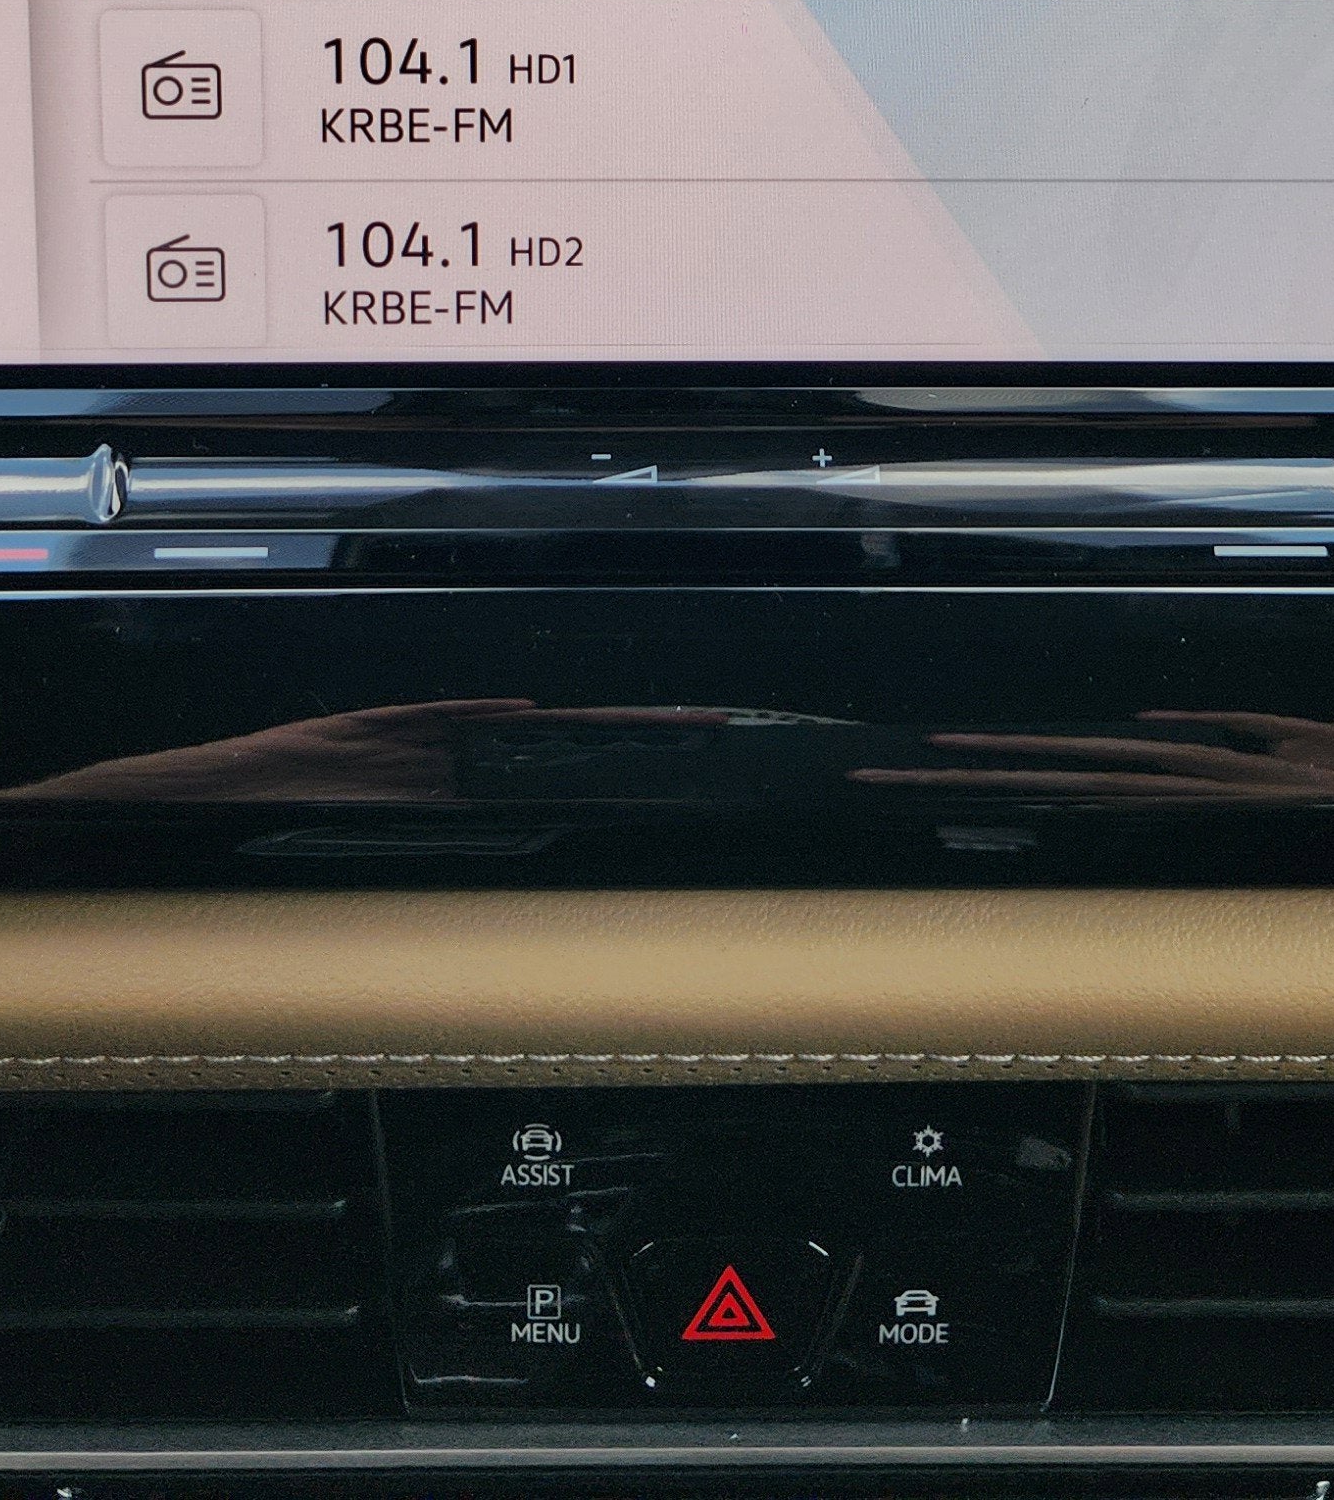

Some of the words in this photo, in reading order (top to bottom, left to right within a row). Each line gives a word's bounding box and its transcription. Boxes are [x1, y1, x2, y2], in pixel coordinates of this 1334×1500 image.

[323, 36, 479, 87] 104.1
[508, 53, 576, 85] HD1
[320, 106, 513, 144] KRBE-FM
[326, 220, 480, 269] 104.1
[509, 235, 584, 268] HD2
[323, 289, 513, 326] KRBE-FM
[500, 1163, 575, 1187] ASSIST
[891, 1164, 963, 1188] CLIMA
[534, 1288, 555, 1315] P
[510, 1321, 581, 1345] MENU
[878, 1322, 949, 1345] MODE
